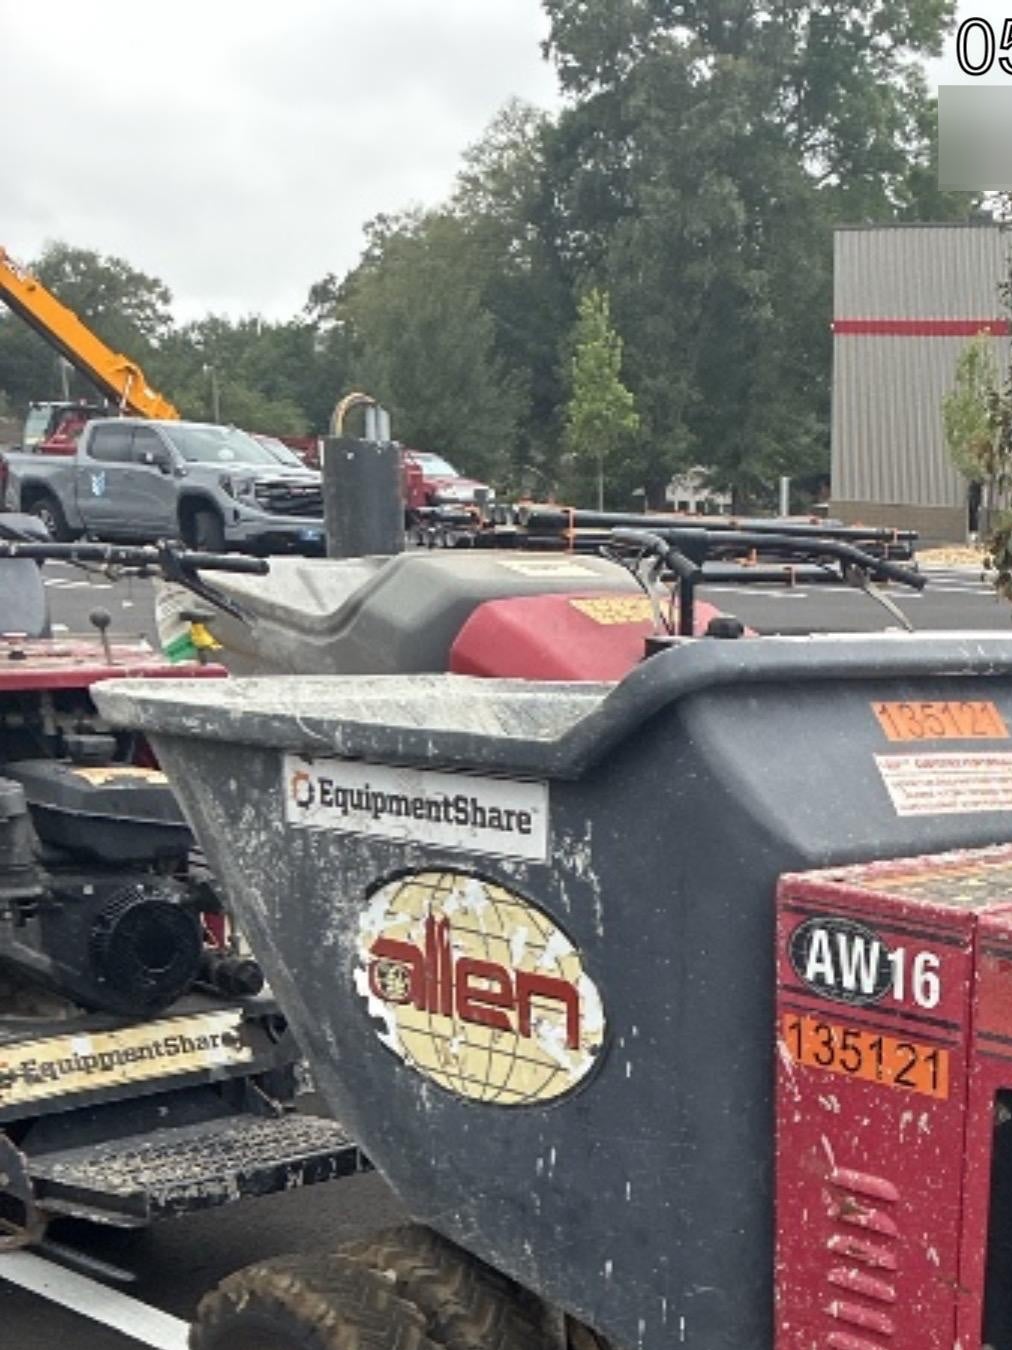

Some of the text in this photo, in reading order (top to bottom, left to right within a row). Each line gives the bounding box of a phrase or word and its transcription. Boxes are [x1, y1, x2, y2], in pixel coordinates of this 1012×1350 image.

[879, 702, 1003, 738] 135121
[318, 777, 532, 834] EquipmentShare
[369, 910, 580, 1050] allen
[806, 929, 940, 1009] AW16
[20, 1031, 238, 1083] EquipmentShar
[788, 1022, 938, 1090] 135121
